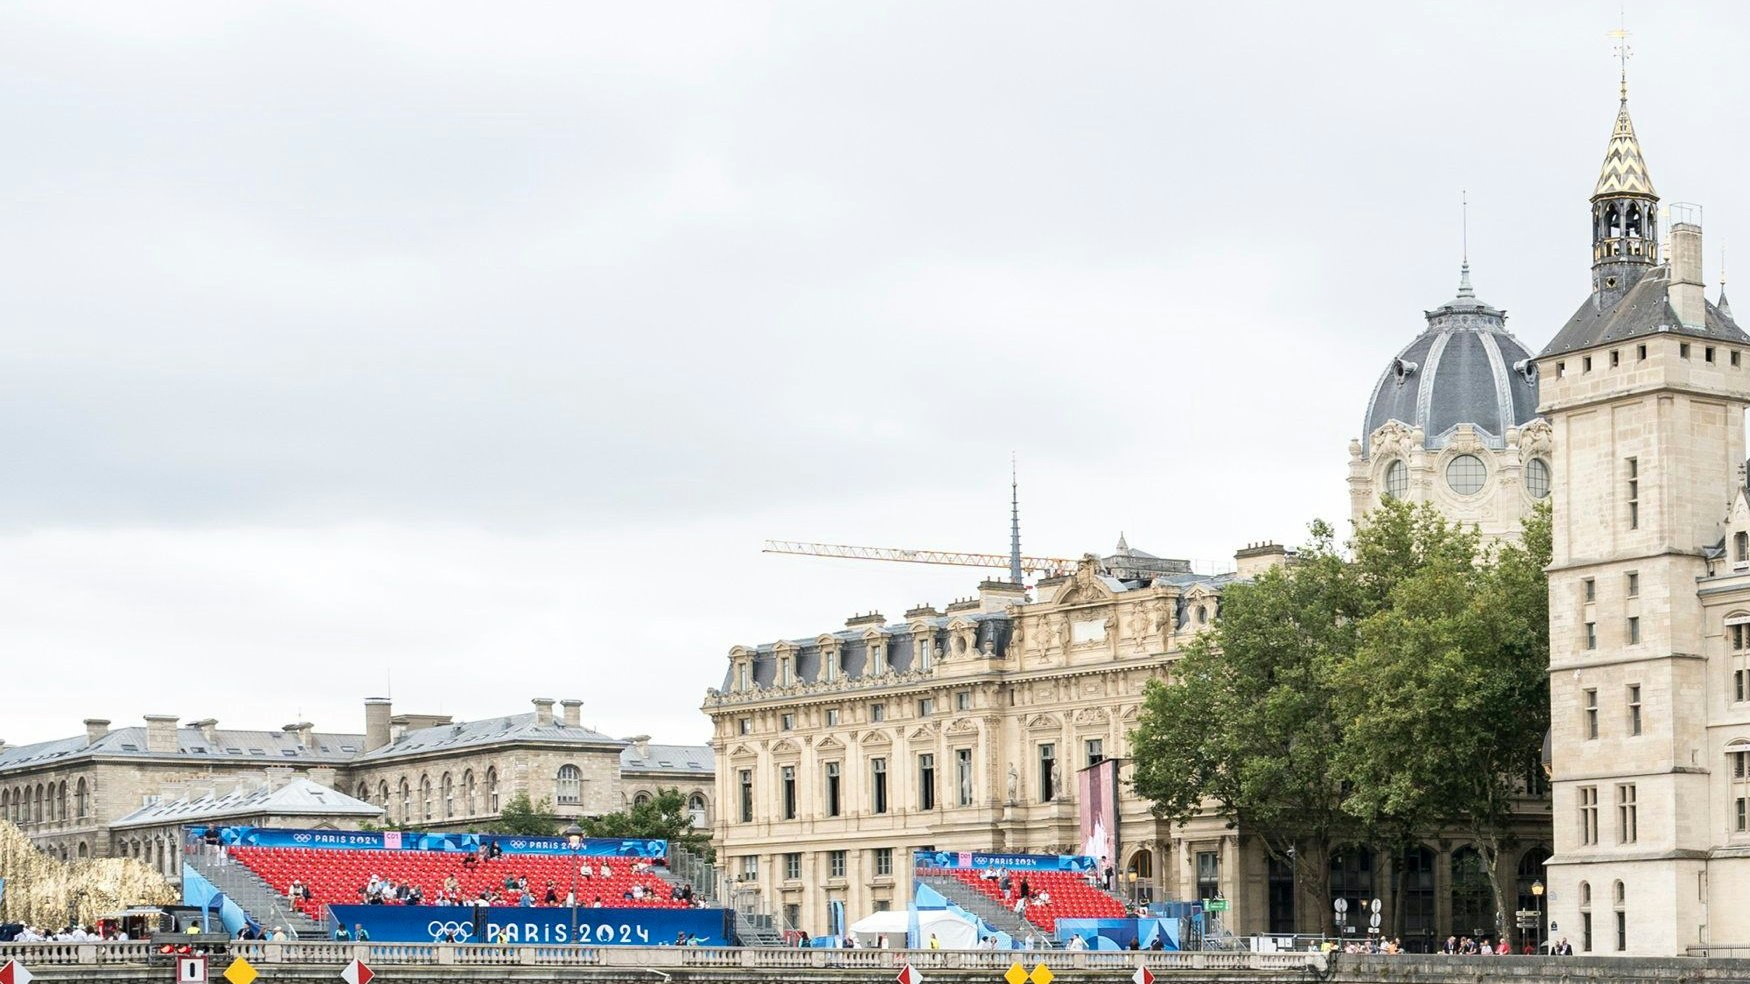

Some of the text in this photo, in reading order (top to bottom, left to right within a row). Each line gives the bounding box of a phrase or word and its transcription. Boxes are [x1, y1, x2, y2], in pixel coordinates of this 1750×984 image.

[315, 834, 378, 845] PARIS 2024
[529, 841, 559, 850] PARIS
[989, 857, 1037, 866] PARIS 2024
[579, 924, 649, 943] 2024
